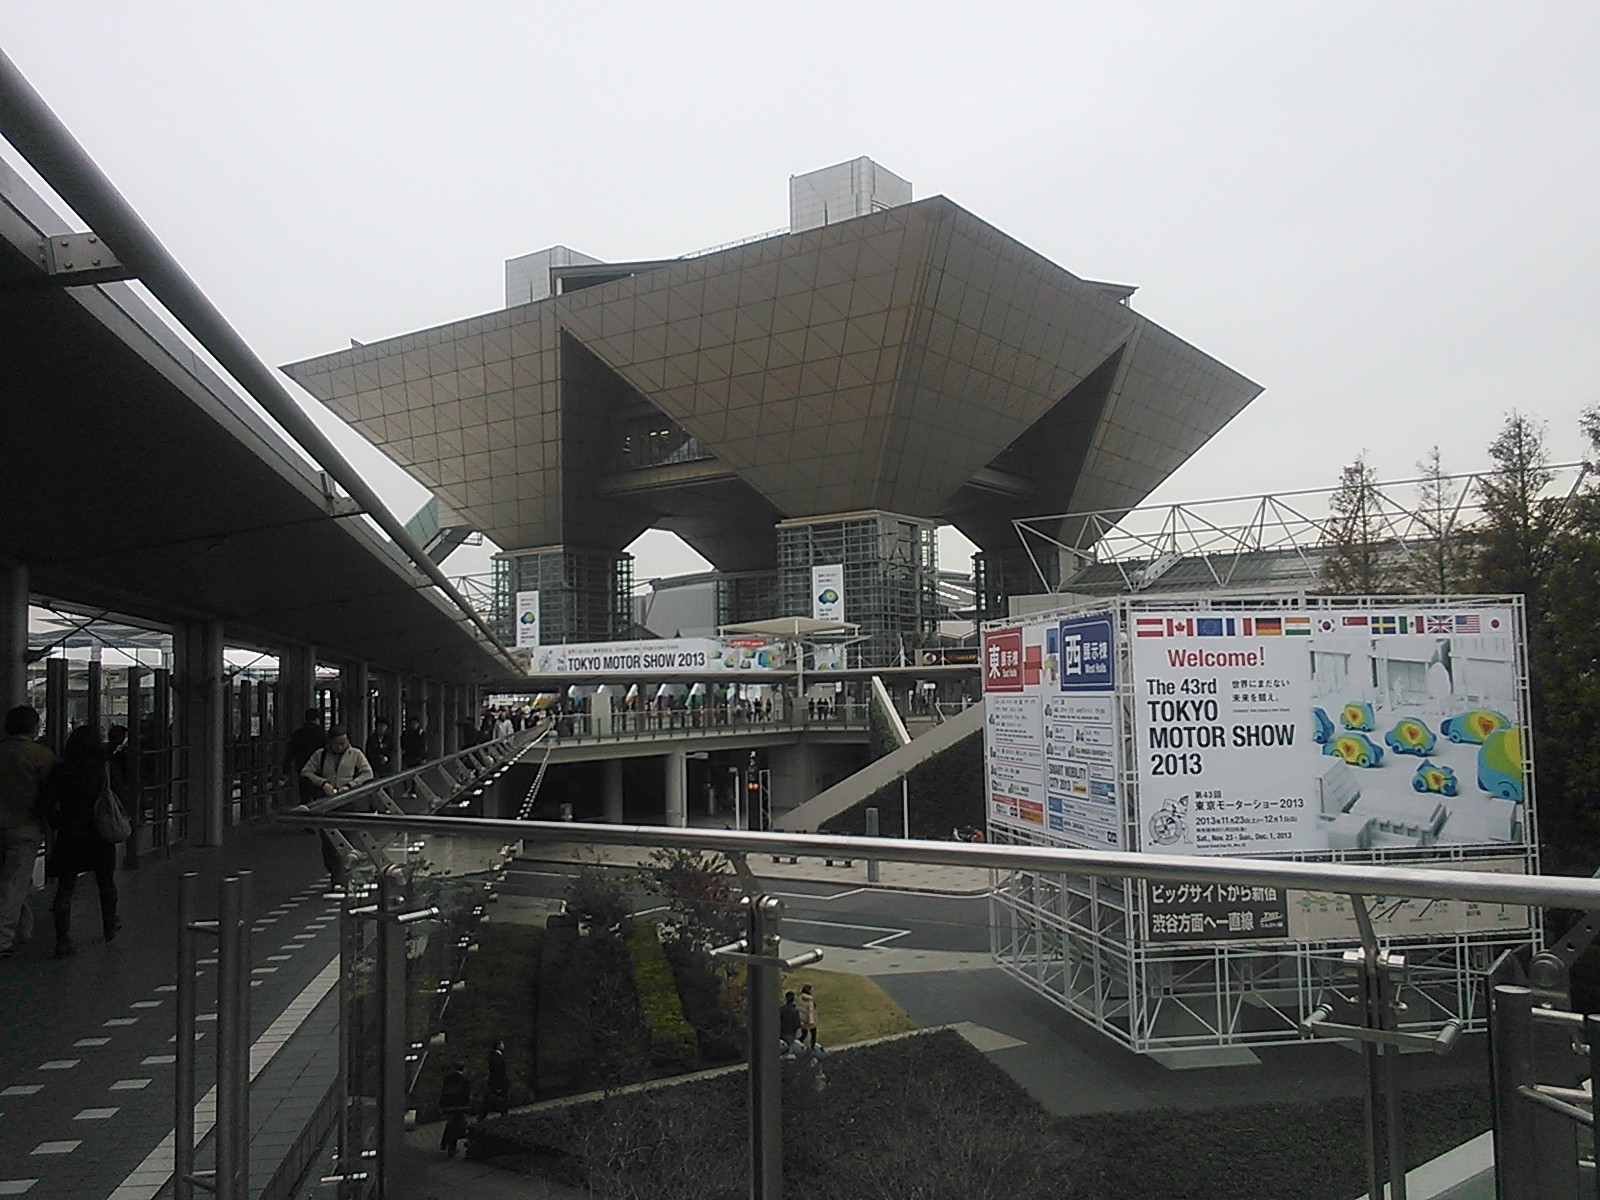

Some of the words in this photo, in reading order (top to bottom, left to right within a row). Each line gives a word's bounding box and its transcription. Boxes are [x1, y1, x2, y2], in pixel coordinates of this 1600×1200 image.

[568, 656, 600, 671] TOKYO
[603, 654, 641, 670] MOTOR
[643, 652, 676, 668] SHOW
[678, 652, 706, 667] 2013
[988, 644, 1001, 680] 東
[1065, 634, 1081, 676] 西
[1083, 641, 1108, 661] 展示棟
[1167, 646, 1265, 668] Welcome!
[1146, 679, 1175, 695] The
[1180, 678, 1217, 694] 43rd
[1147, 699, 1218, 722] TOKYO
[1149, 726, 1226, 749] MOTOR
[1232, 724, 1295, 747] SHOW
[1151, 753, 1203, 775] 2013
[1152, 911, 1254, 933] 渋谷方面へ一直線
